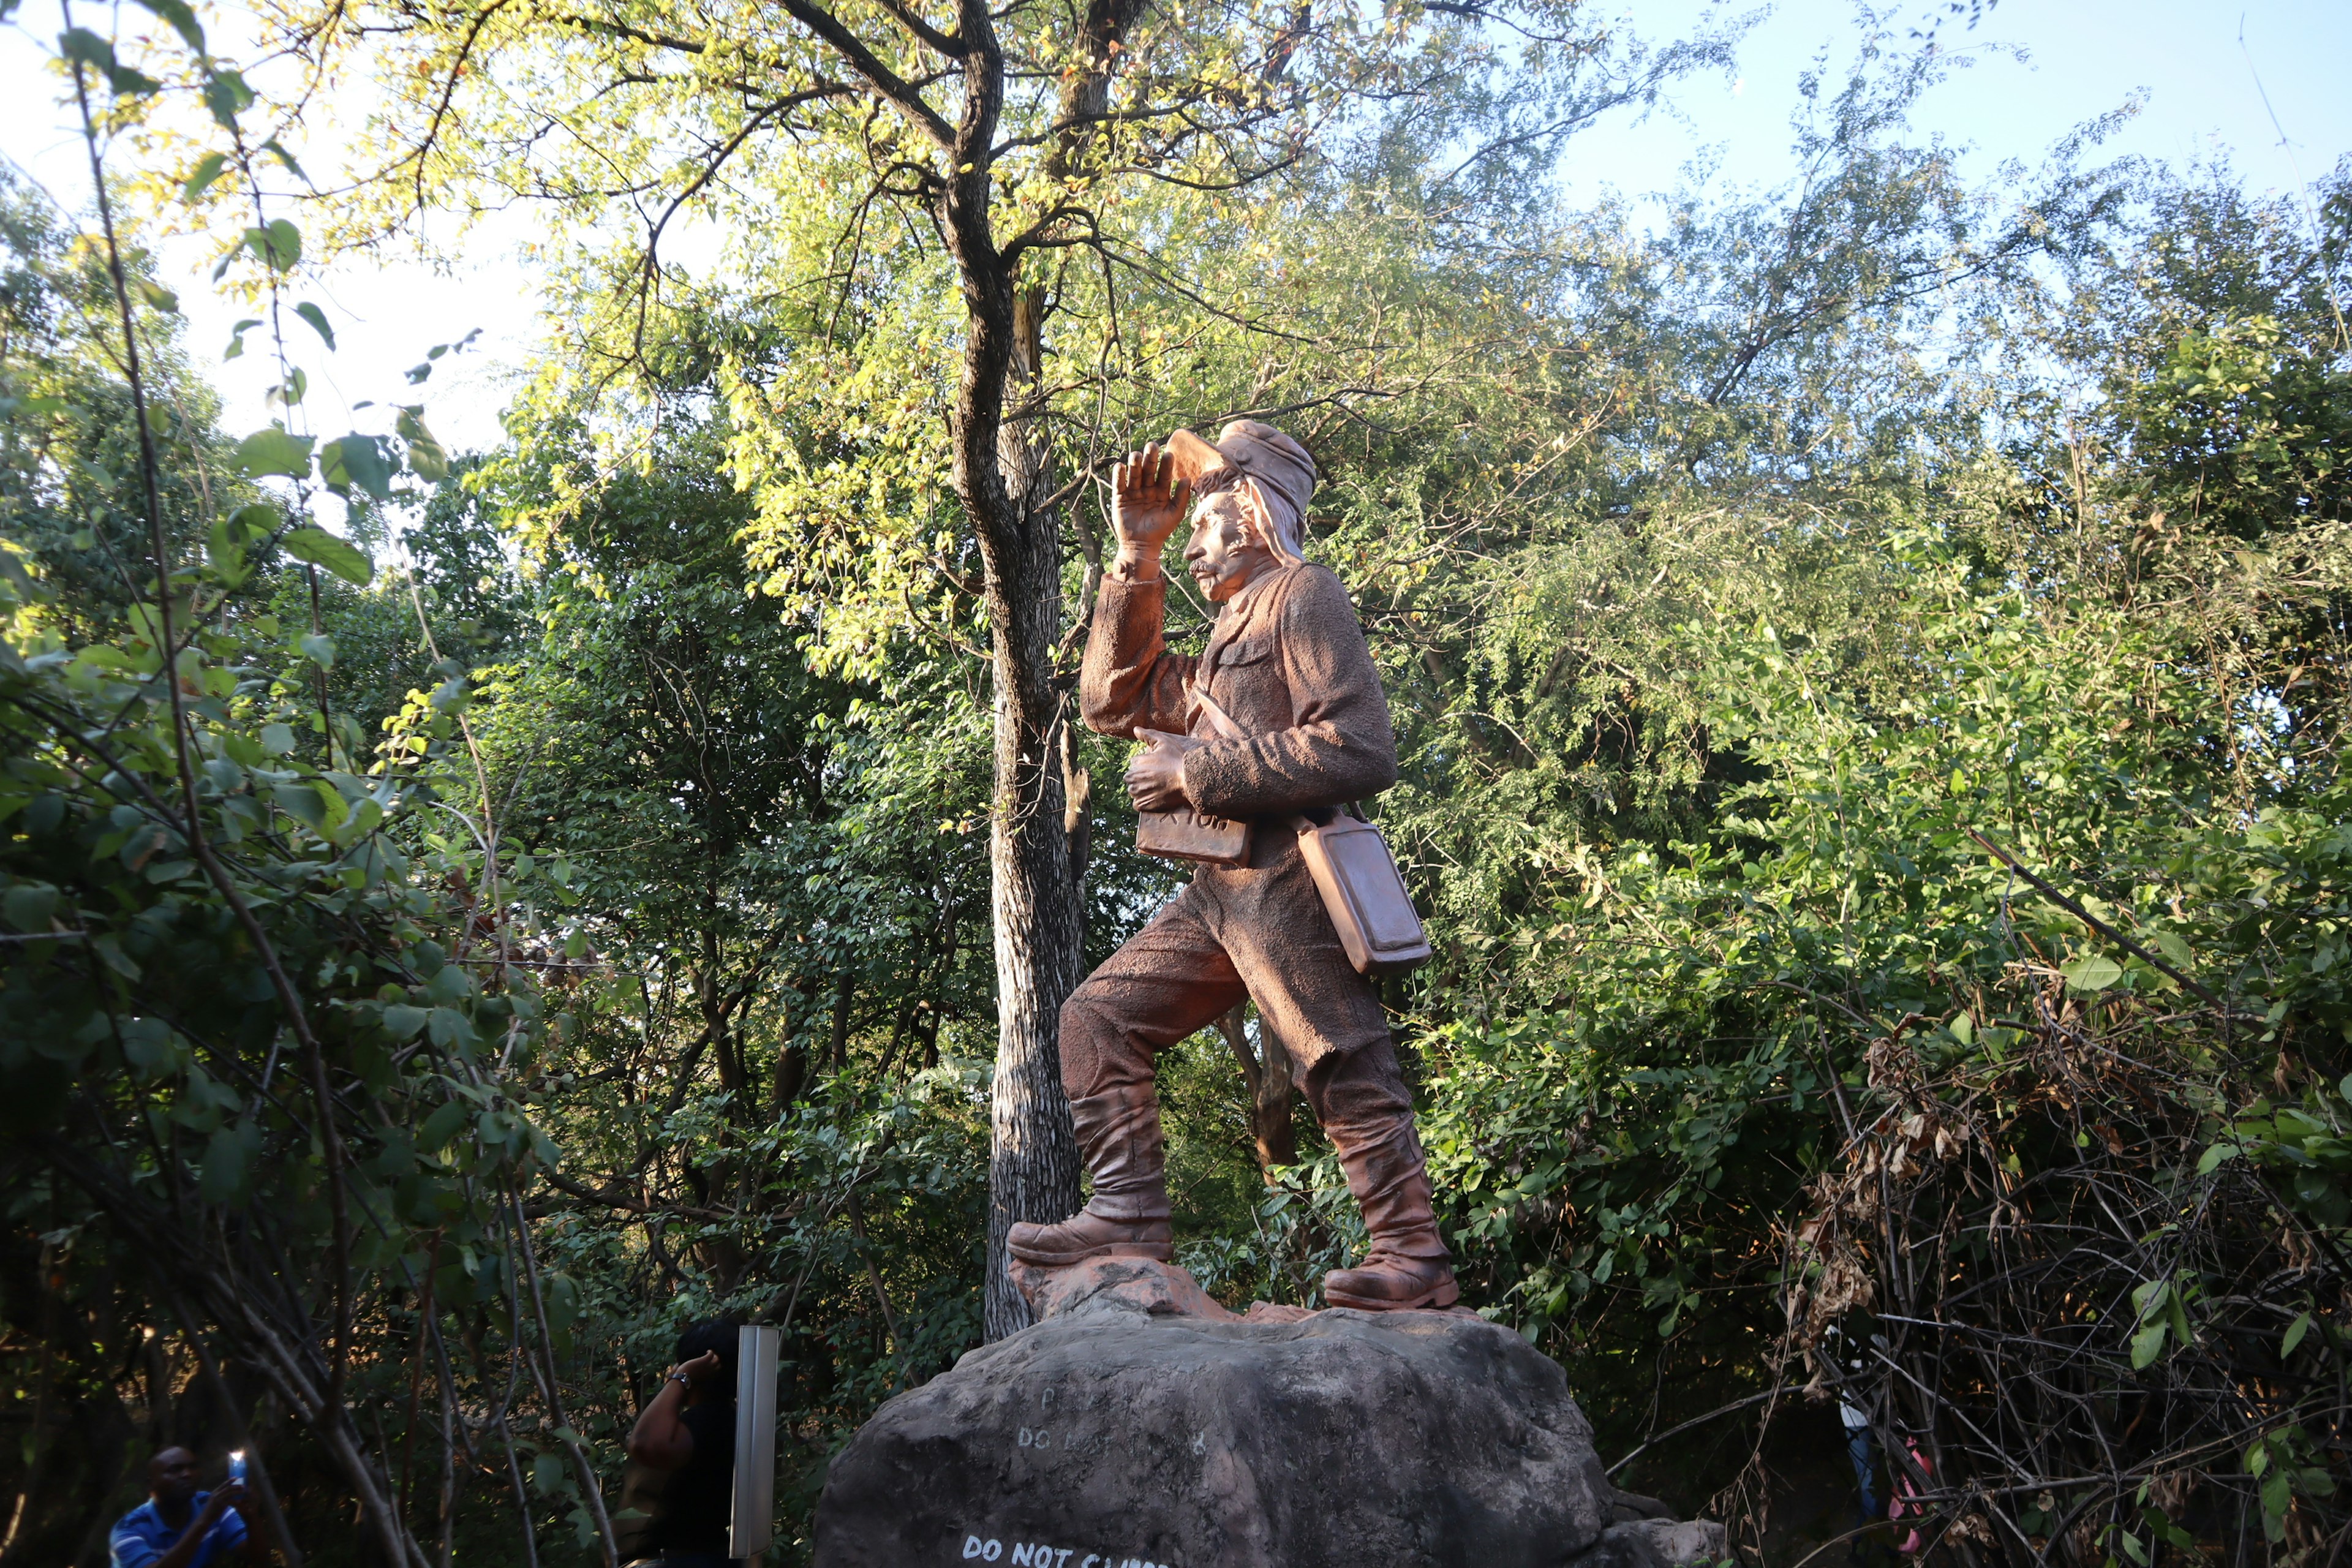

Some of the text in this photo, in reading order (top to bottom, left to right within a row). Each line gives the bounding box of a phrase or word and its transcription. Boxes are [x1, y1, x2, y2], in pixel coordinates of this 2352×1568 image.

[1018, 1427, 1050, 1449] DO
[962, 1535, 1002, 1561] DO
[1011, 1542, 1073, 1568] NOT
